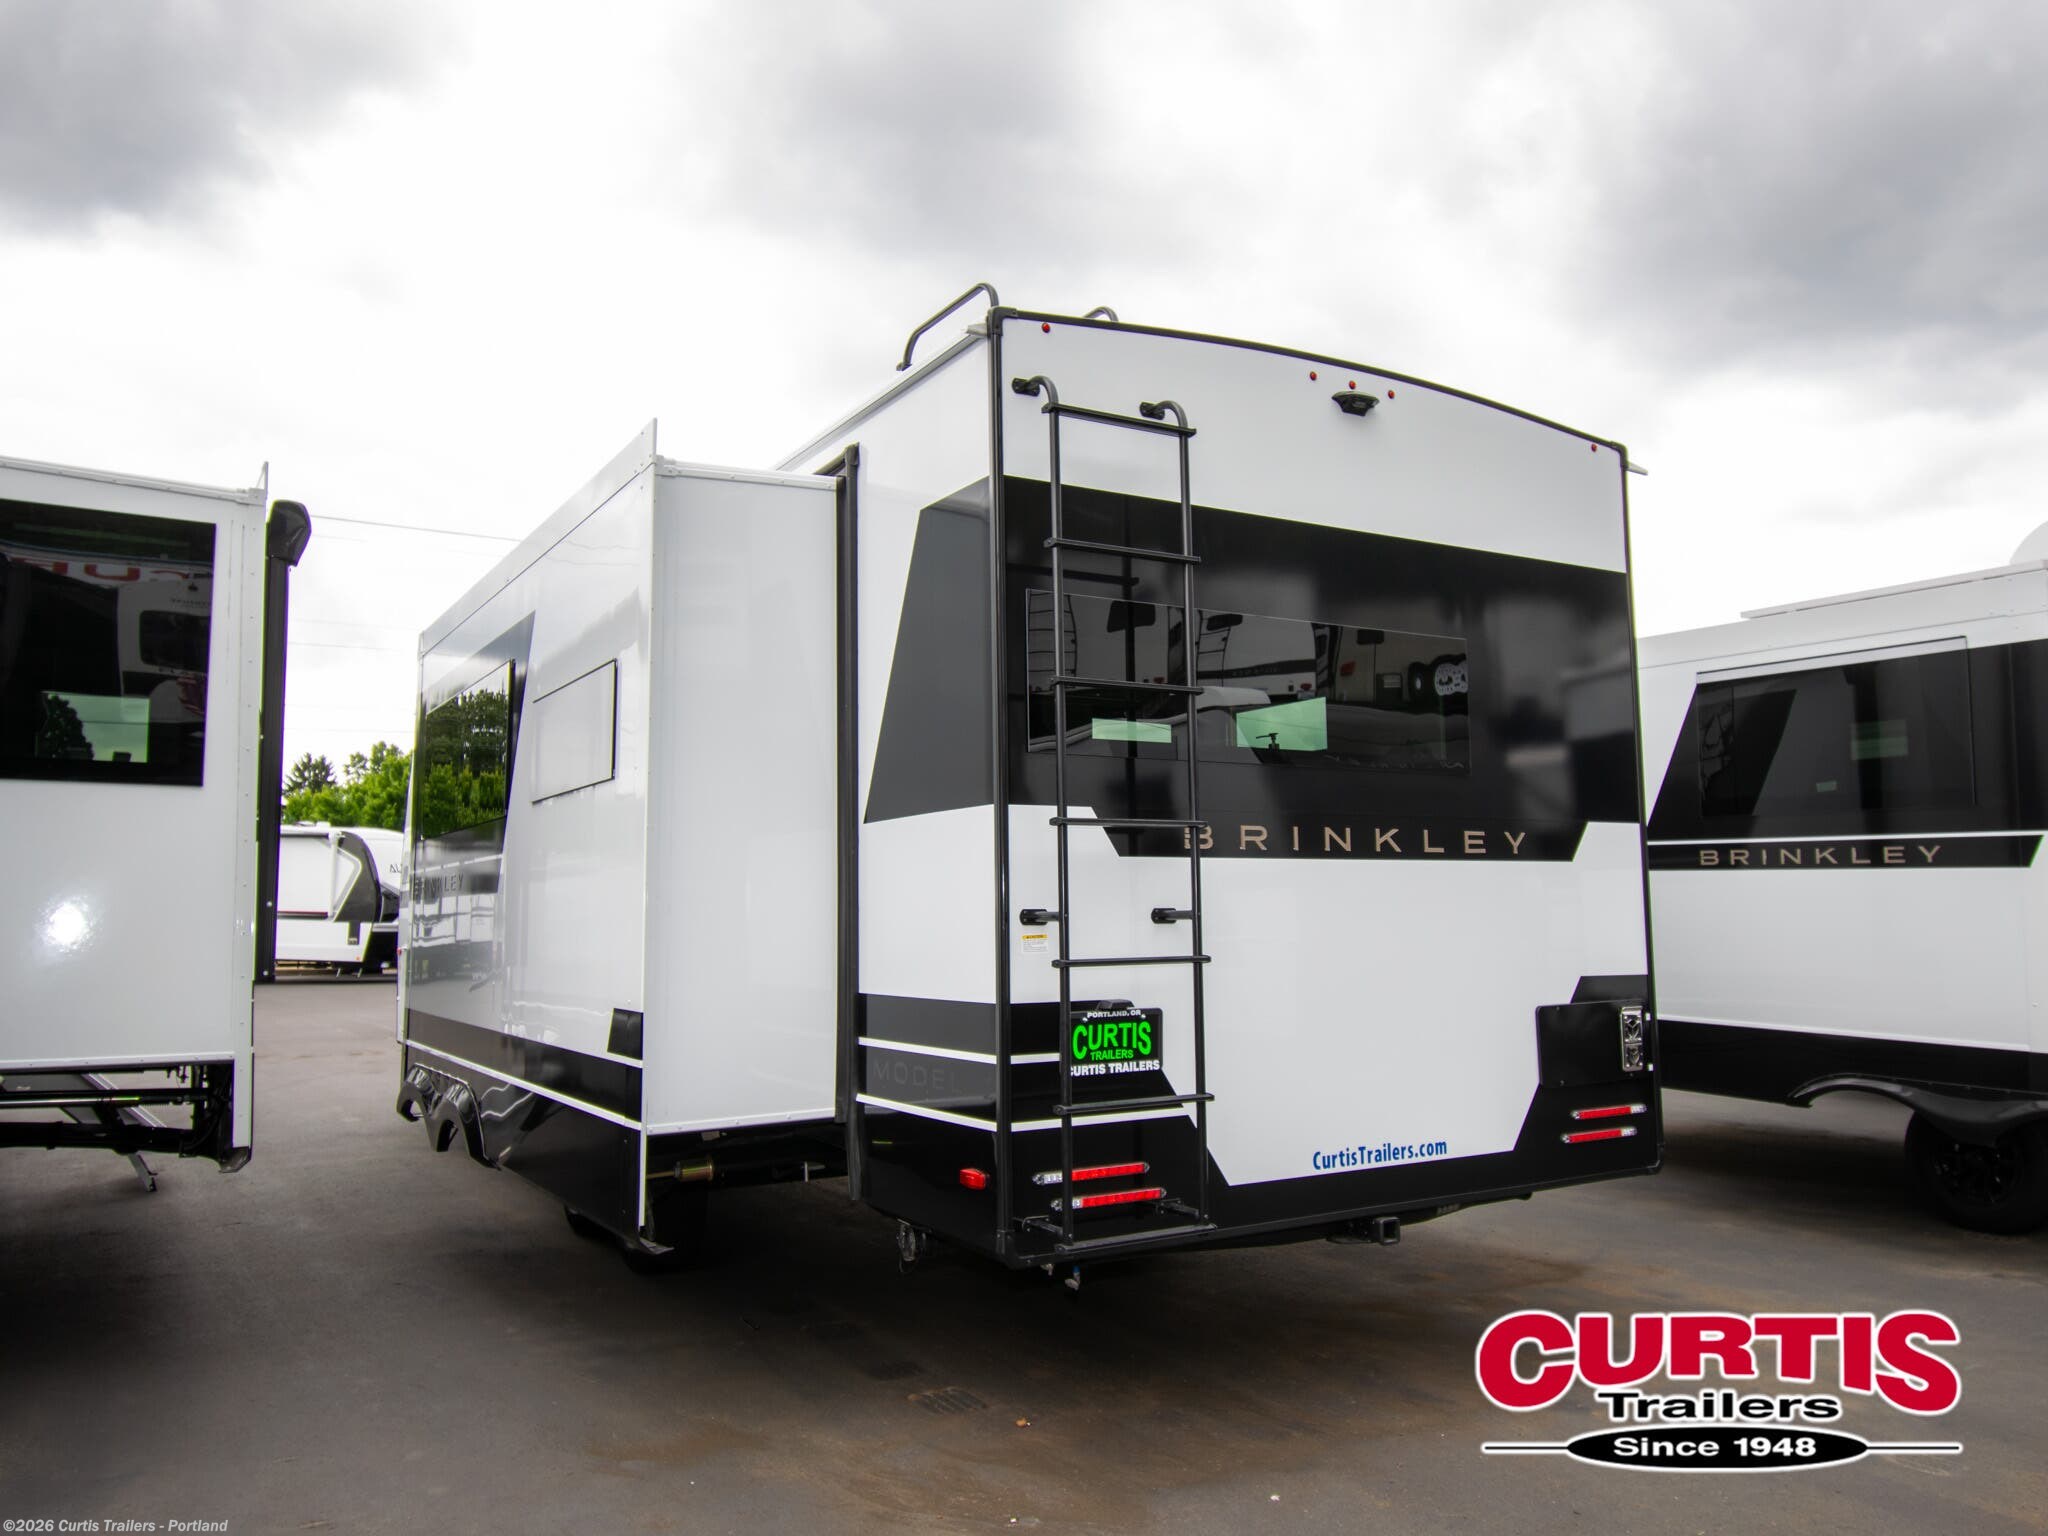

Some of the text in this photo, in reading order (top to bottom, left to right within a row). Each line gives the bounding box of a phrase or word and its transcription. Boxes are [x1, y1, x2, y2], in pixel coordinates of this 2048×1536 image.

[1184, 824, 1526, 855] BRINKLEY
[1699, 845, 1941, 866] BRINKLEY
[1072, 1021, 1152, 1060] CURTIS
[1090, 1049, 1134, 1061] TRAILERS
[873, 1057, 963, 1095] MODEL
[1070, 1060, 1161, 1077] URTIS TRAILERS
[1312, 1140, 1448, 1171] CurtisTrailers.com
